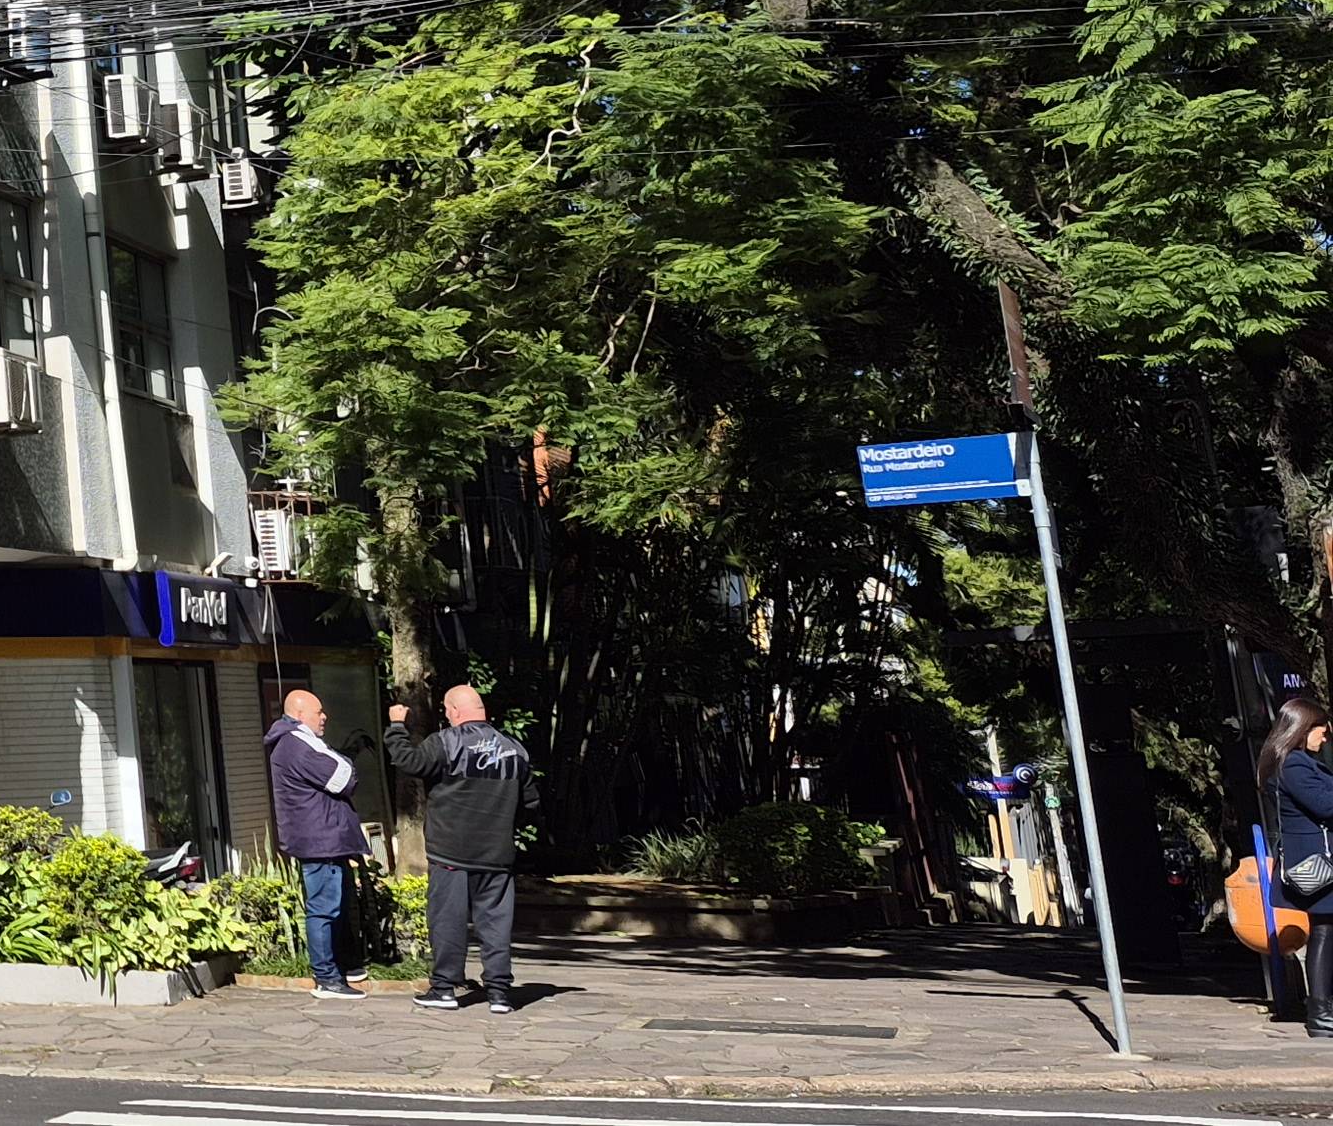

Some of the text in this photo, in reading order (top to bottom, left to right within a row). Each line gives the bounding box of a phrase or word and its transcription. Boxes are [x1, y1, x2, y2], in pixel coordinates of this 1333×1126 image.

[859, 442, 955, 462] Mostardeiro
[862, 459, 945, 474] Rua Mostardeiro
[180, 586, 228, 628] PanVel
